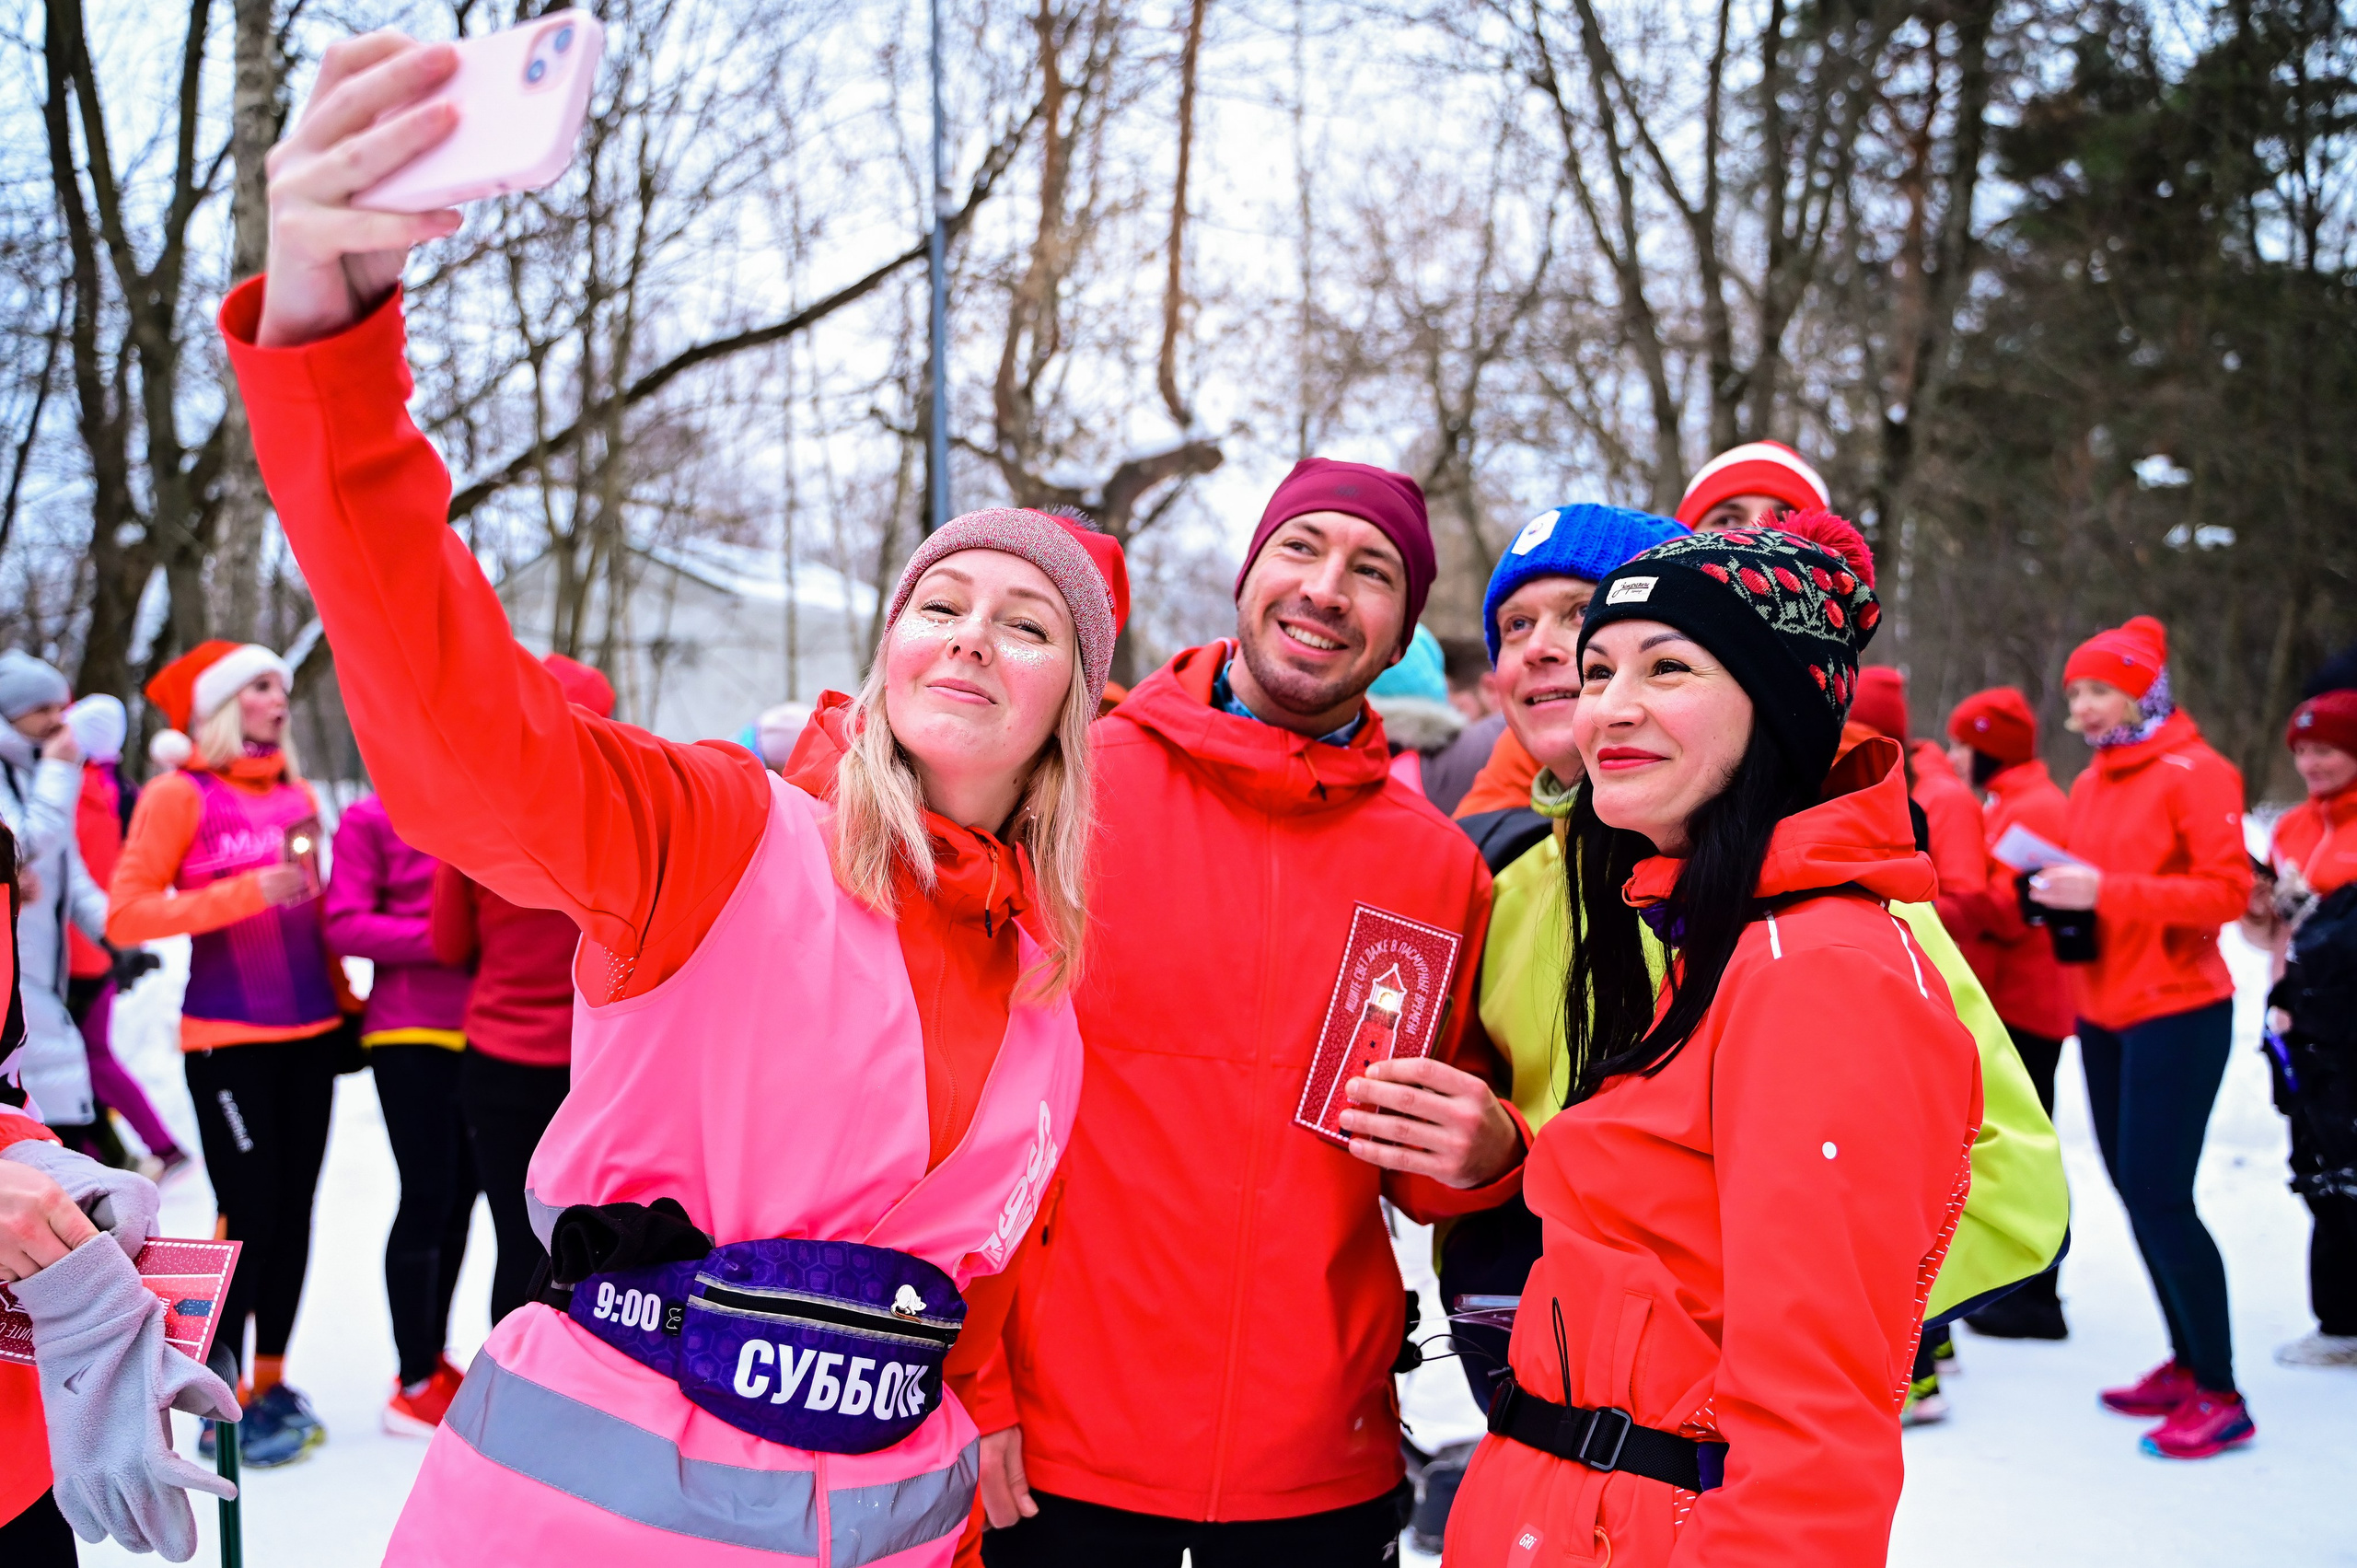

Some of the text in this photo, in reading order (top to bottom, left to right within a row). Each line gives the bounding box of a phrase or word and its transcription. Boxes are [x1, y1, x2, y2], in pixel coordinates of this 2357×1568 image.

[1344, 939, 1430, 1035] ИЩИТЕ СВЕТ ДАЖЕ В ПАСМУРНЫЕ ВРЕМЕНА
[593, 1282, 661, 1331] 9:00
